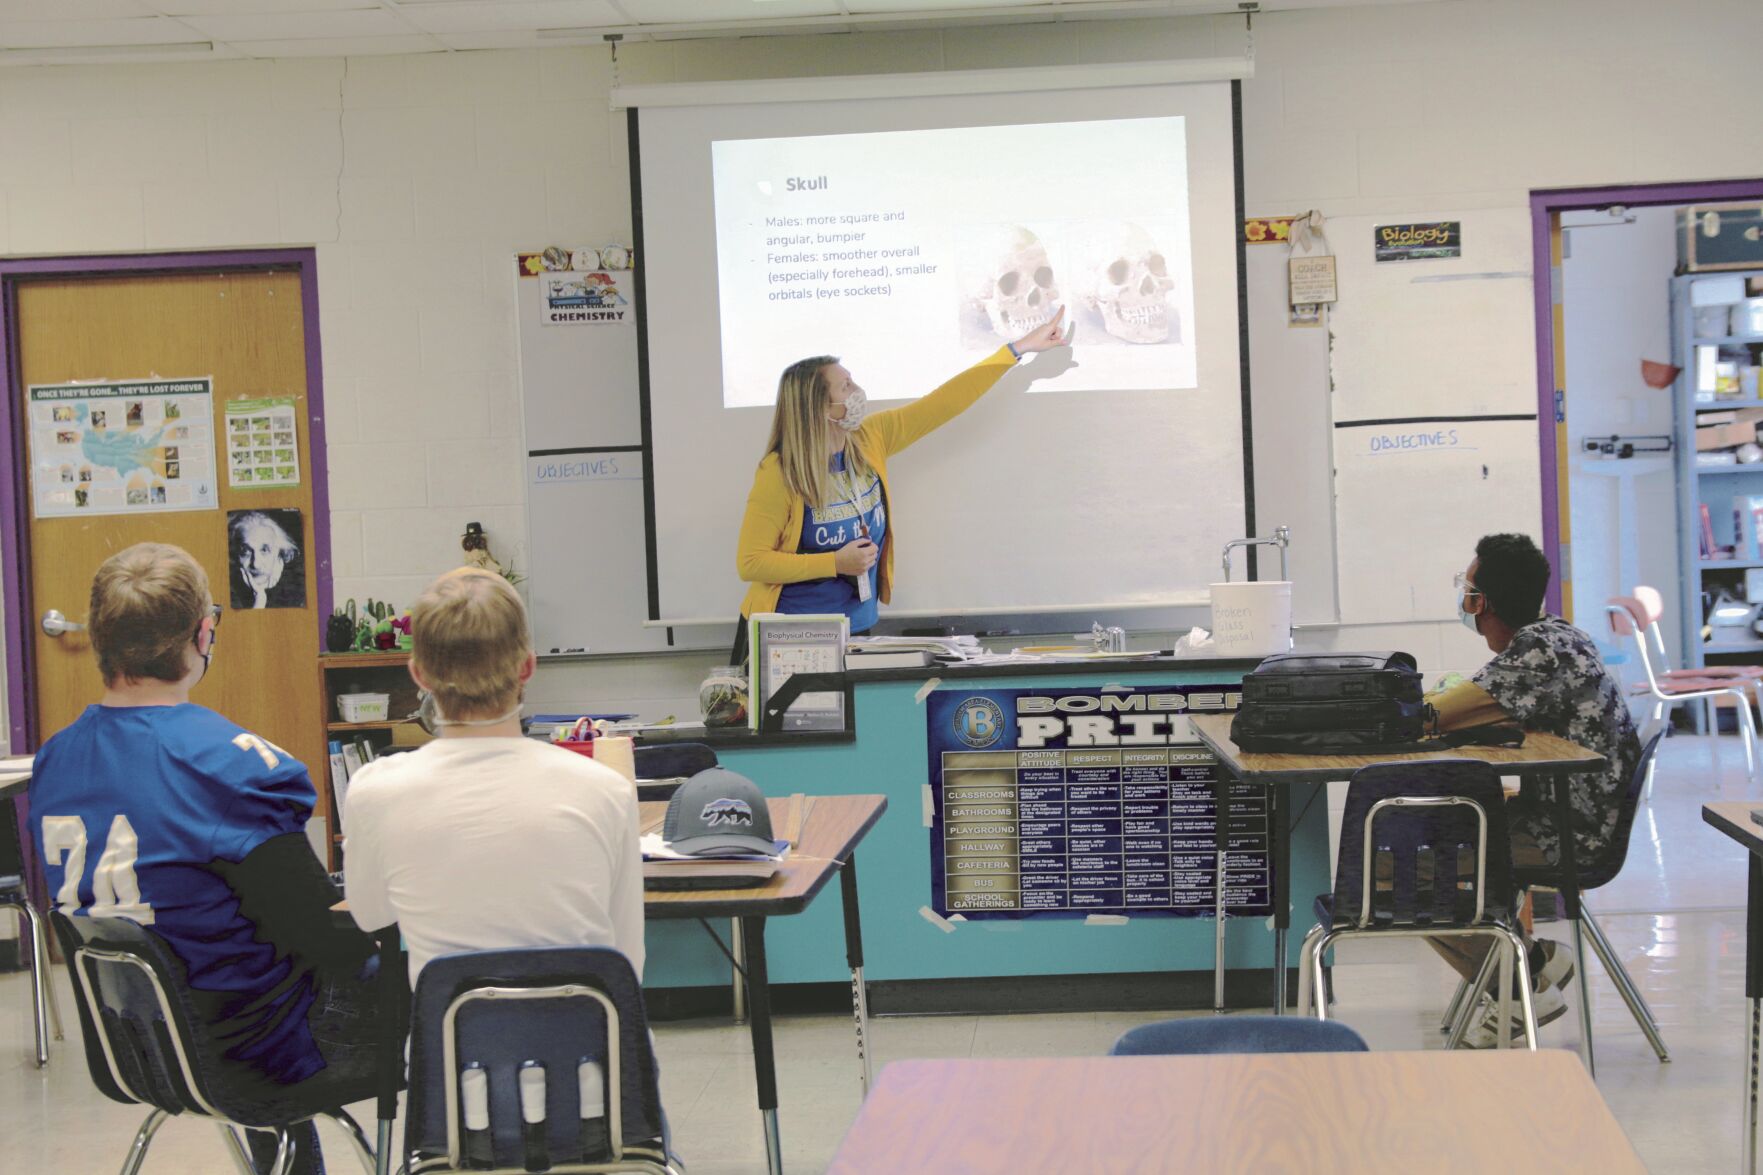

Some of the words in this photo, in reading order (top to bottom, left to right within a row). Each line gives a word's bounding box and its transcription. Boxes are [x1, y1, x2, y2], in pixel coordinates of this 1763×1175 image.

[786, 176, 828, 191] Skull
[765, 216, 803, 227] Males:
[806, 215, 836, 225] more
[840, 213, 879, 224] square
[883, 211, 905, 222] and
[766, 234, 814, 247] angular,
[817, 231, 866, 245] bumpier
[1382, 225, 1449, 244] Biology
[767, 252, 819, 264] Females:
[822, 248, 878, 262] smoother
[881, 246, 920, 258] overall
[768, 269, 829, 284] (especially
[895, 264, 937, 276] smaller
[768, 288, 812, 301] orbitals
[816, 286, 840, 299] (eye
[844, 284, 892, 297] sockets)
[550, 311, 624, 322] CHEMISTRY
[59, 389, 89, 397] THEY'RE
[118, 386, 149, 394] THEY'RE
[169, 384, 203, 392] FOREVER
[1370, 429, 1458, 451] OBJECTIVES
[816, 525, 846, 545] Cut
[966, 707, 996, 737] B
[948, 791, 1014, 799] CLASSROOMS
[952, 808, 1012, 816] BATHROOMS
[950, 826, 1015, 834] PLAYGROUND
[954, 900, 1015, 908] GATHERINGS
